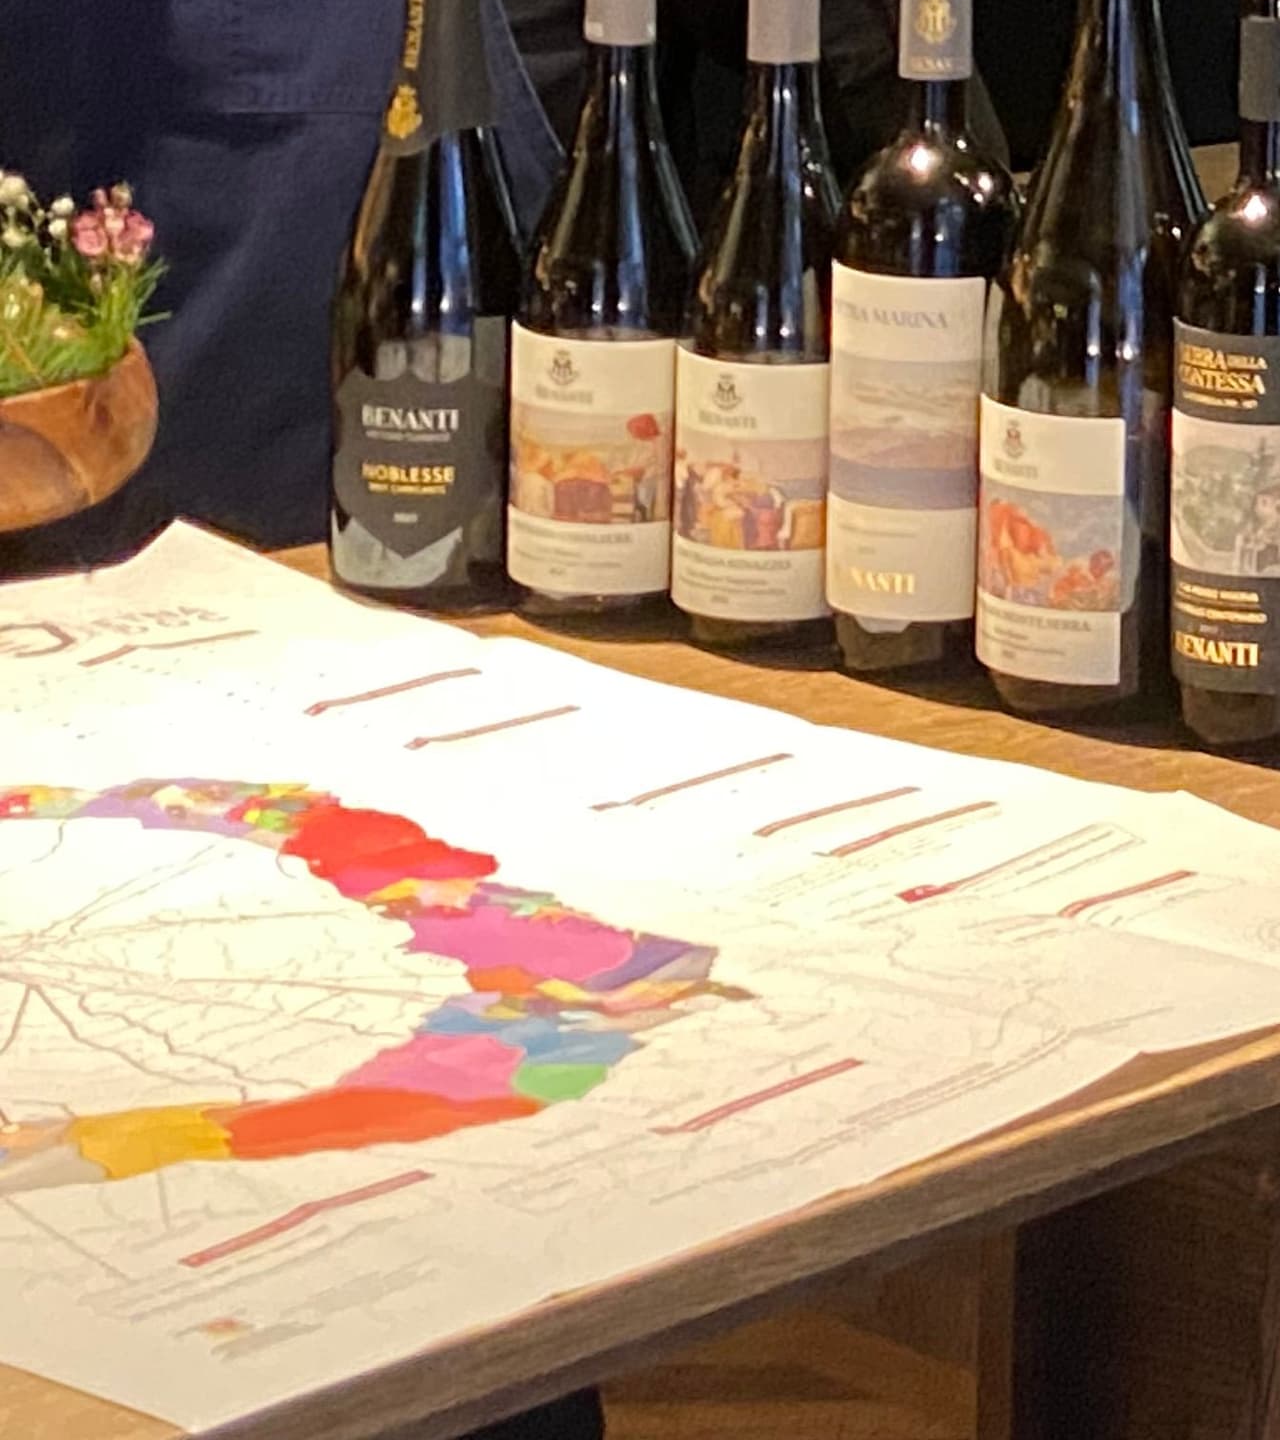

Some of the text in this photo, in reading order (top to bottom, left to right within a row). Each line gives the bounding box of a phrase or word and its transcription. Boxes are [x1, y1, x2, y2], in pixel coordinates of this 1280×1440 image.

[361, 404, 460, 432] BENANTI
[361, 463, 456, 484] NOBLESSE
[851, 567, 915, 594] NANTI
[1175, 631, 1259, 667] BENANTI
